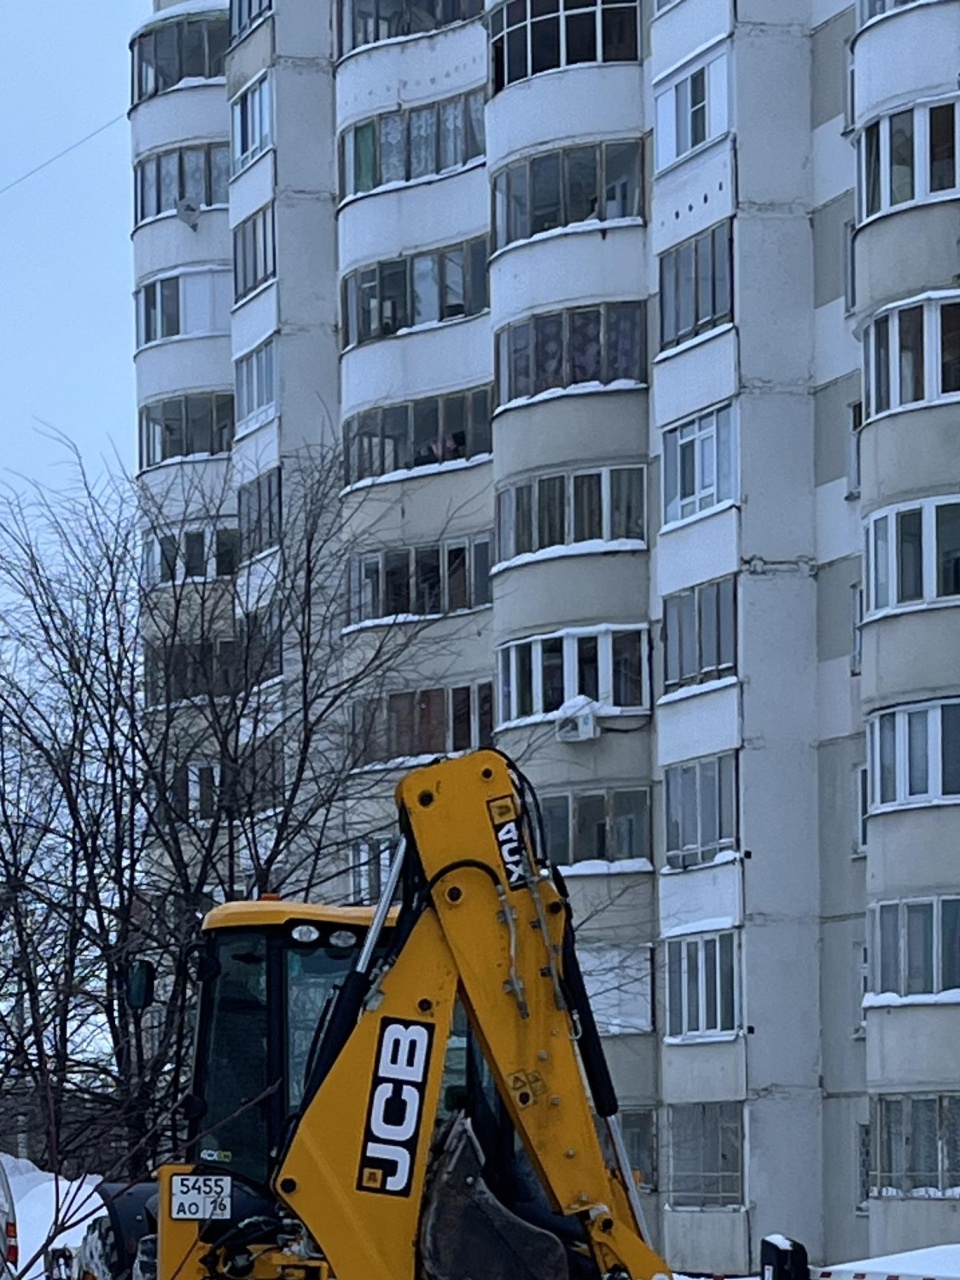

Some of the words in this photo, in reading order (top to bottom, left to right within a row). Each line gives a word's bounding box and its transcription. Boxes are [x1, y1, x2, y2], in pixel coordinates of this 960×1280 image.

[498, 821, 525, 882] 4CX
[366, 1024, 429, 1191] JCB
[179, 1177, 225, 1196] 5455
[210, 1197, 227, 1212] 16
